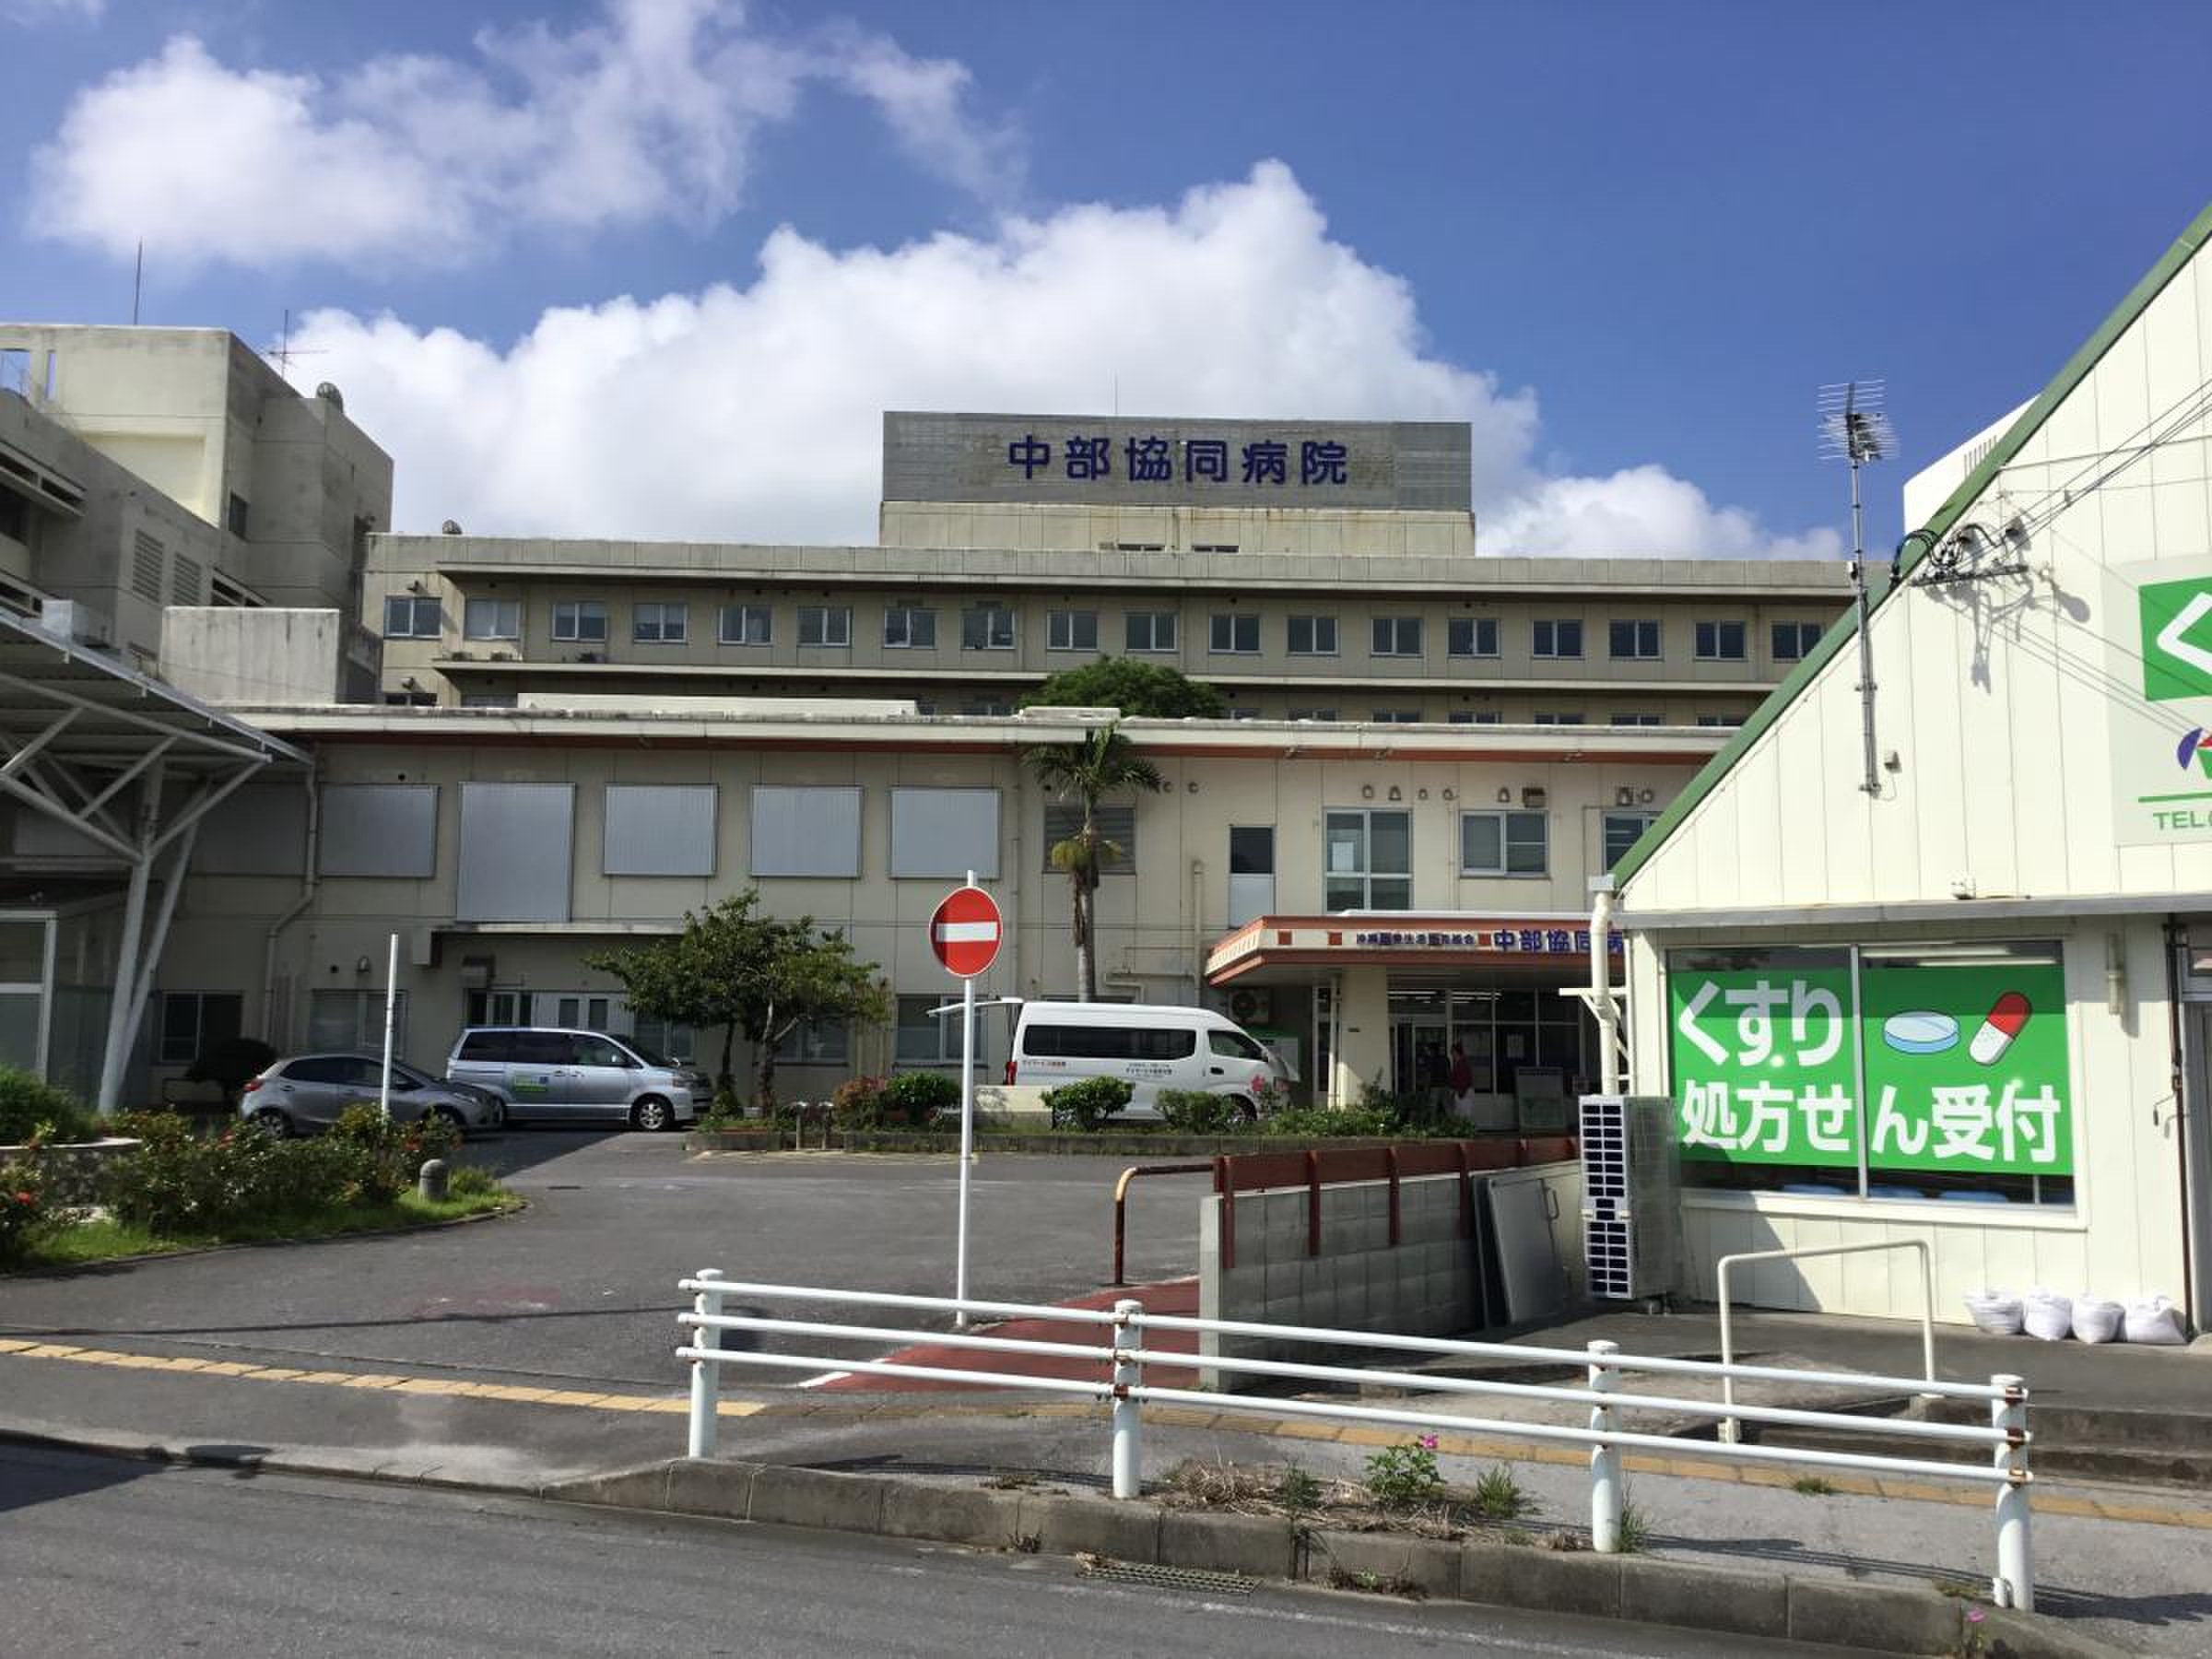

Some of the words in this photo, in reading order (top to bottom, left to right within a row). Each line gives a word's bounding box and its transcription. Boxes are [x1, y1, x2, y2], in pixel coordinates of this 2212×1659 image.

[1007, 434, 1347, 485] 中部協同病院
[1677, 979, 1843, 1067] くすり
[1680, 1079, 2061, 1163] 処方せん受付
